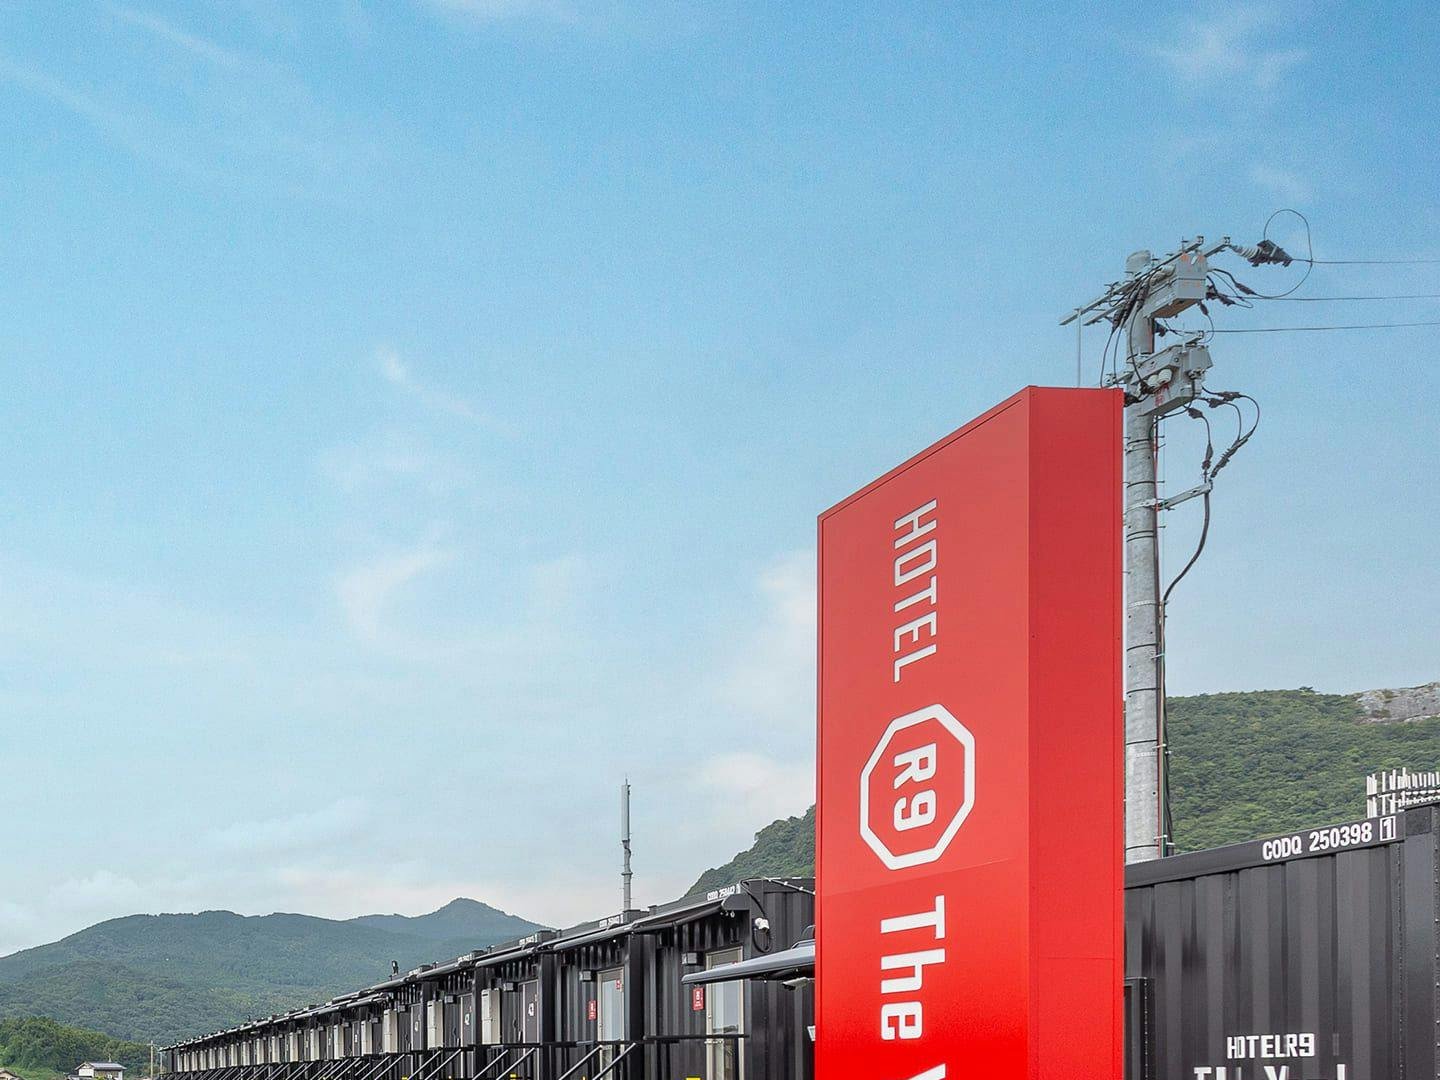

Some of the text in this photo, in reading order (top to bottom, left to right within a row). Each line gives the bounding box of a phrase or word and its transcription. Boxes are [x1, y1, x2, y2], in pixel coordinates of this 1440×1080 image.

[892, 500, 938, 684] HOTEL
[891, 743, 938, 832] R9
[1262, 835, 1303, 861] CODQ
[1308, 821, 1373, 852] 250398
[881, 894, 946, 1041] The
